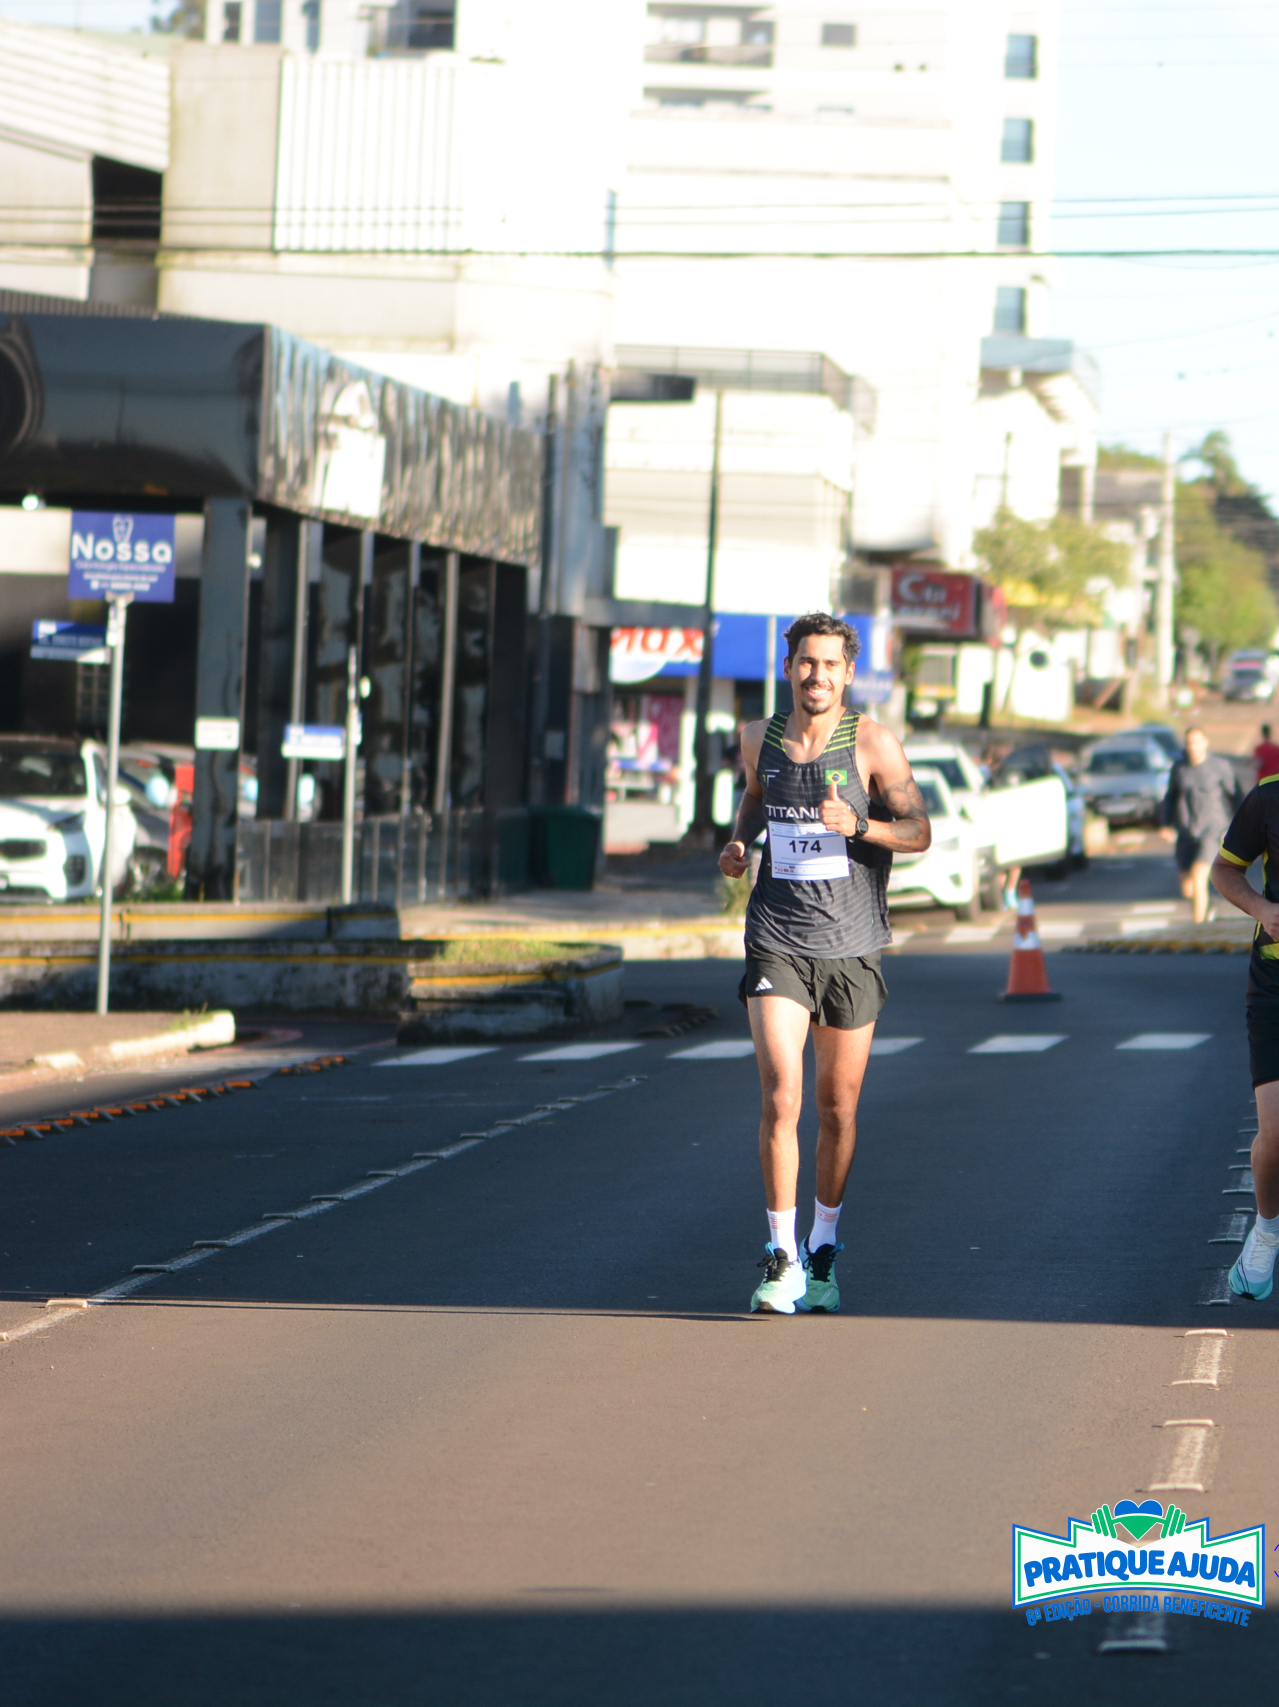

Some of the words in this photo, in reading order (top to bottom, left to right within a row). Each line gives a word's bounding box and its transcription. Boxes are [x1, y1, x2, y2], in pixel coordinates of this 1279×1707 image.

[72, 532, 172, 564] Nossa
[765, 804, 821, 820] TITANI
[788, 839, 822, 854] 174
